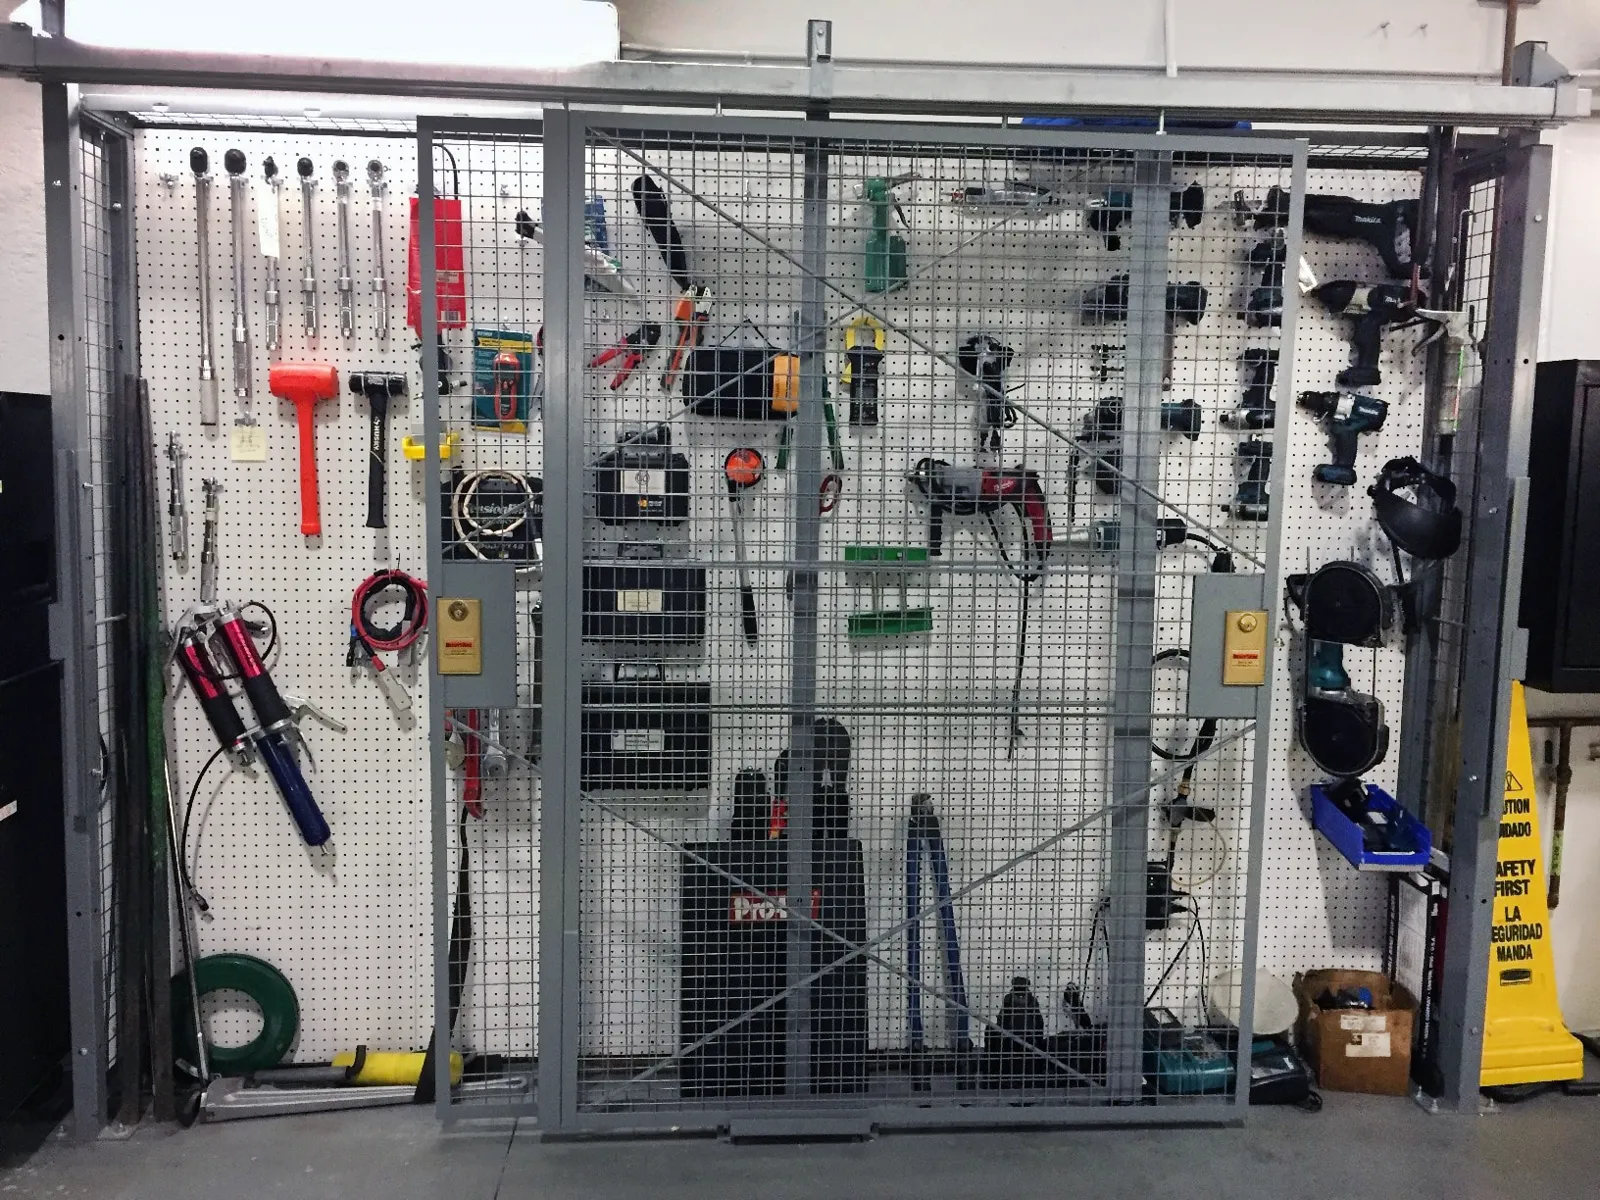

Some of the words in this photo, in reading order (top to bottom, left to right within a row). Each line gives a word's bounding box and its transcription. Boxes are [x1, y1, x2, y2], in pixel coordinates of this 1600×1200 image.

[1503, 798, 1530, 815] UTION
[1498, 822, 1531, 838] UIDADO
[1496, 859, 1536, 878] AFETY
[1494, 879, 1531, 898] FIRST
[1504, 905, 1522, 922] LA
[1491, 923, 1543, 943] EGURIDAD
[1497, 944, 1533, 962] MANDA
